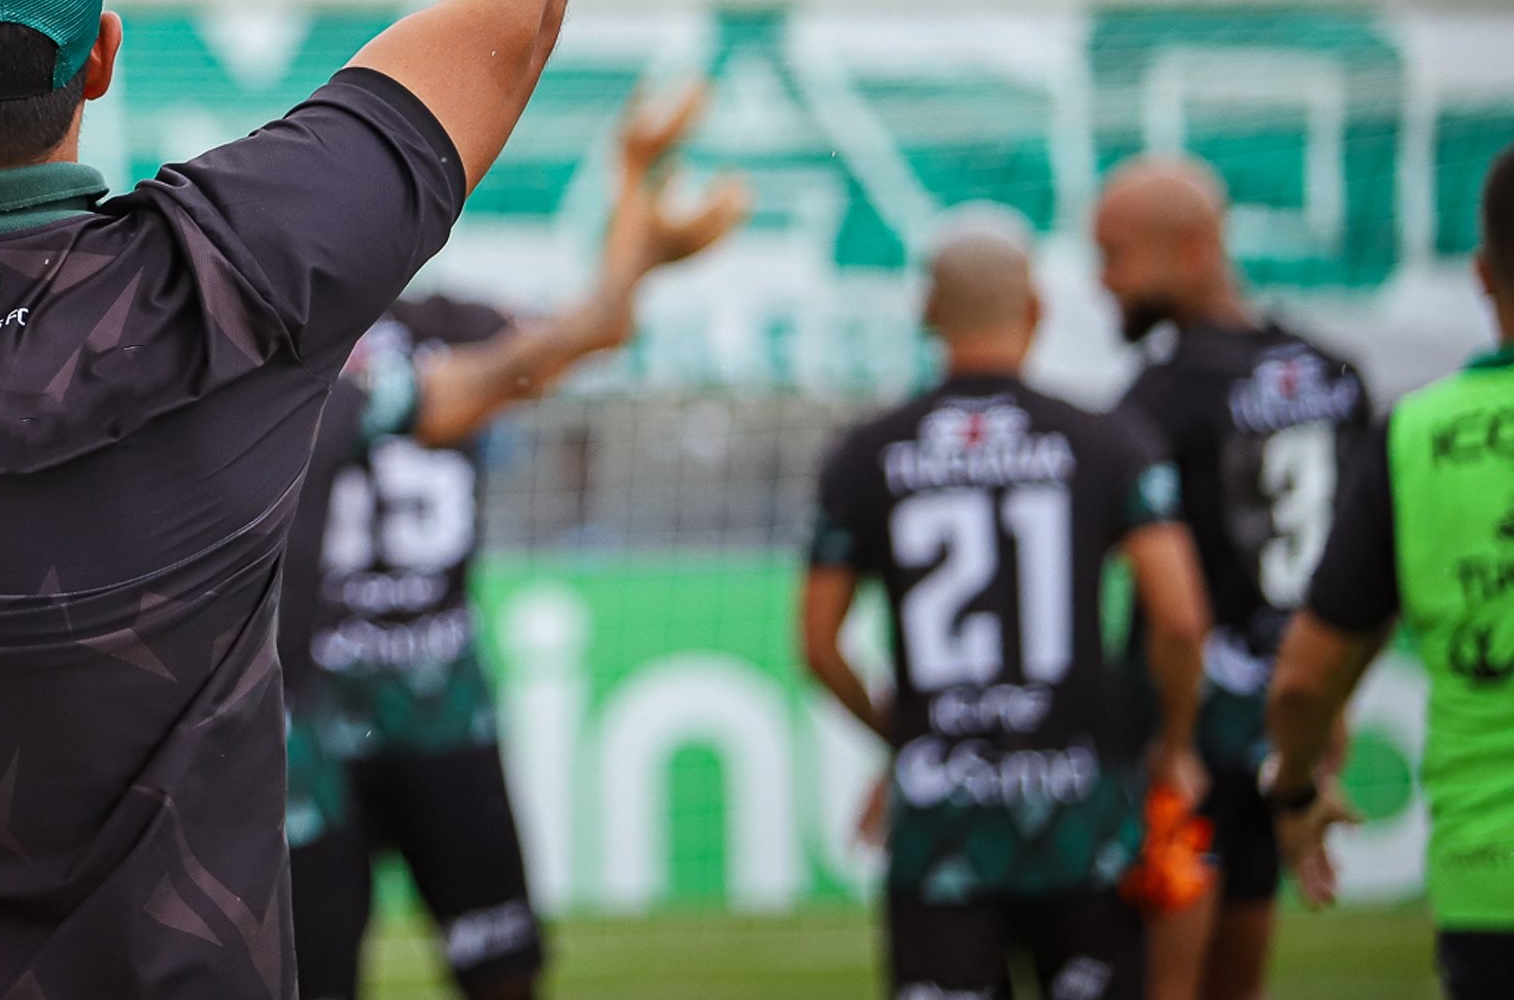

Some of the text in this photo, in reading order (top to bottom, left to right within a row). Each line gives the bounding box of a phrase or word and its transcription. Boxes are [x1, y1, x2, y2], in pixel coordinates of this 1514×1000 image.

[5, 307, 30, 327] FC
[888, 485, 1074, 693] 21
[1259, 416, 1337, 610] 3
